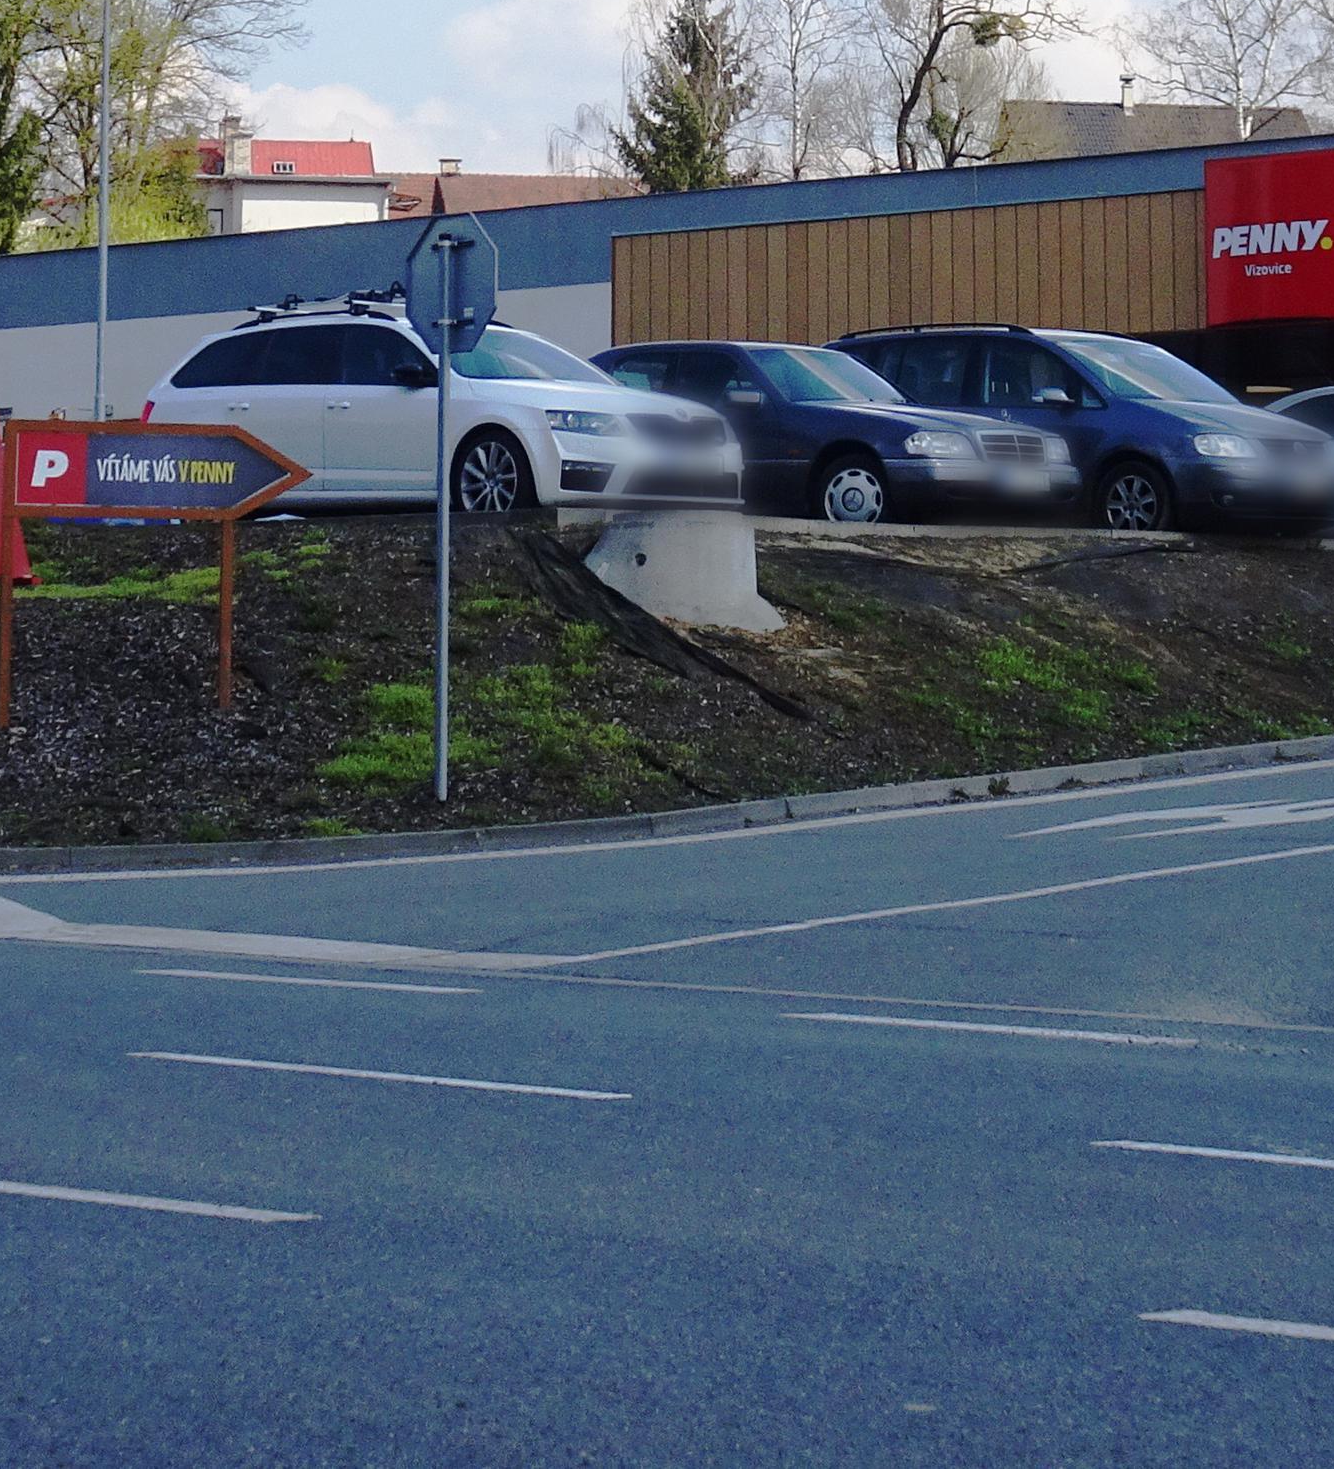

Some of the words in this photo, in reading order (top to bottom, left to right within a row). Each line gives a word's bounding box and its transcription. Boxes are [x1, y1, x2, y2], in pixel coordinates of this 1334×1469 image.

[1244, 262, 1293, 277] Vizovice
[30, 449, 69, 488] P
[96, 452, 150, 483] VÍTÁME
[152, 453, 176, 483] VÁS
[178, 459, 189, 483] V
[190, 461, 236, 485] PENNY
